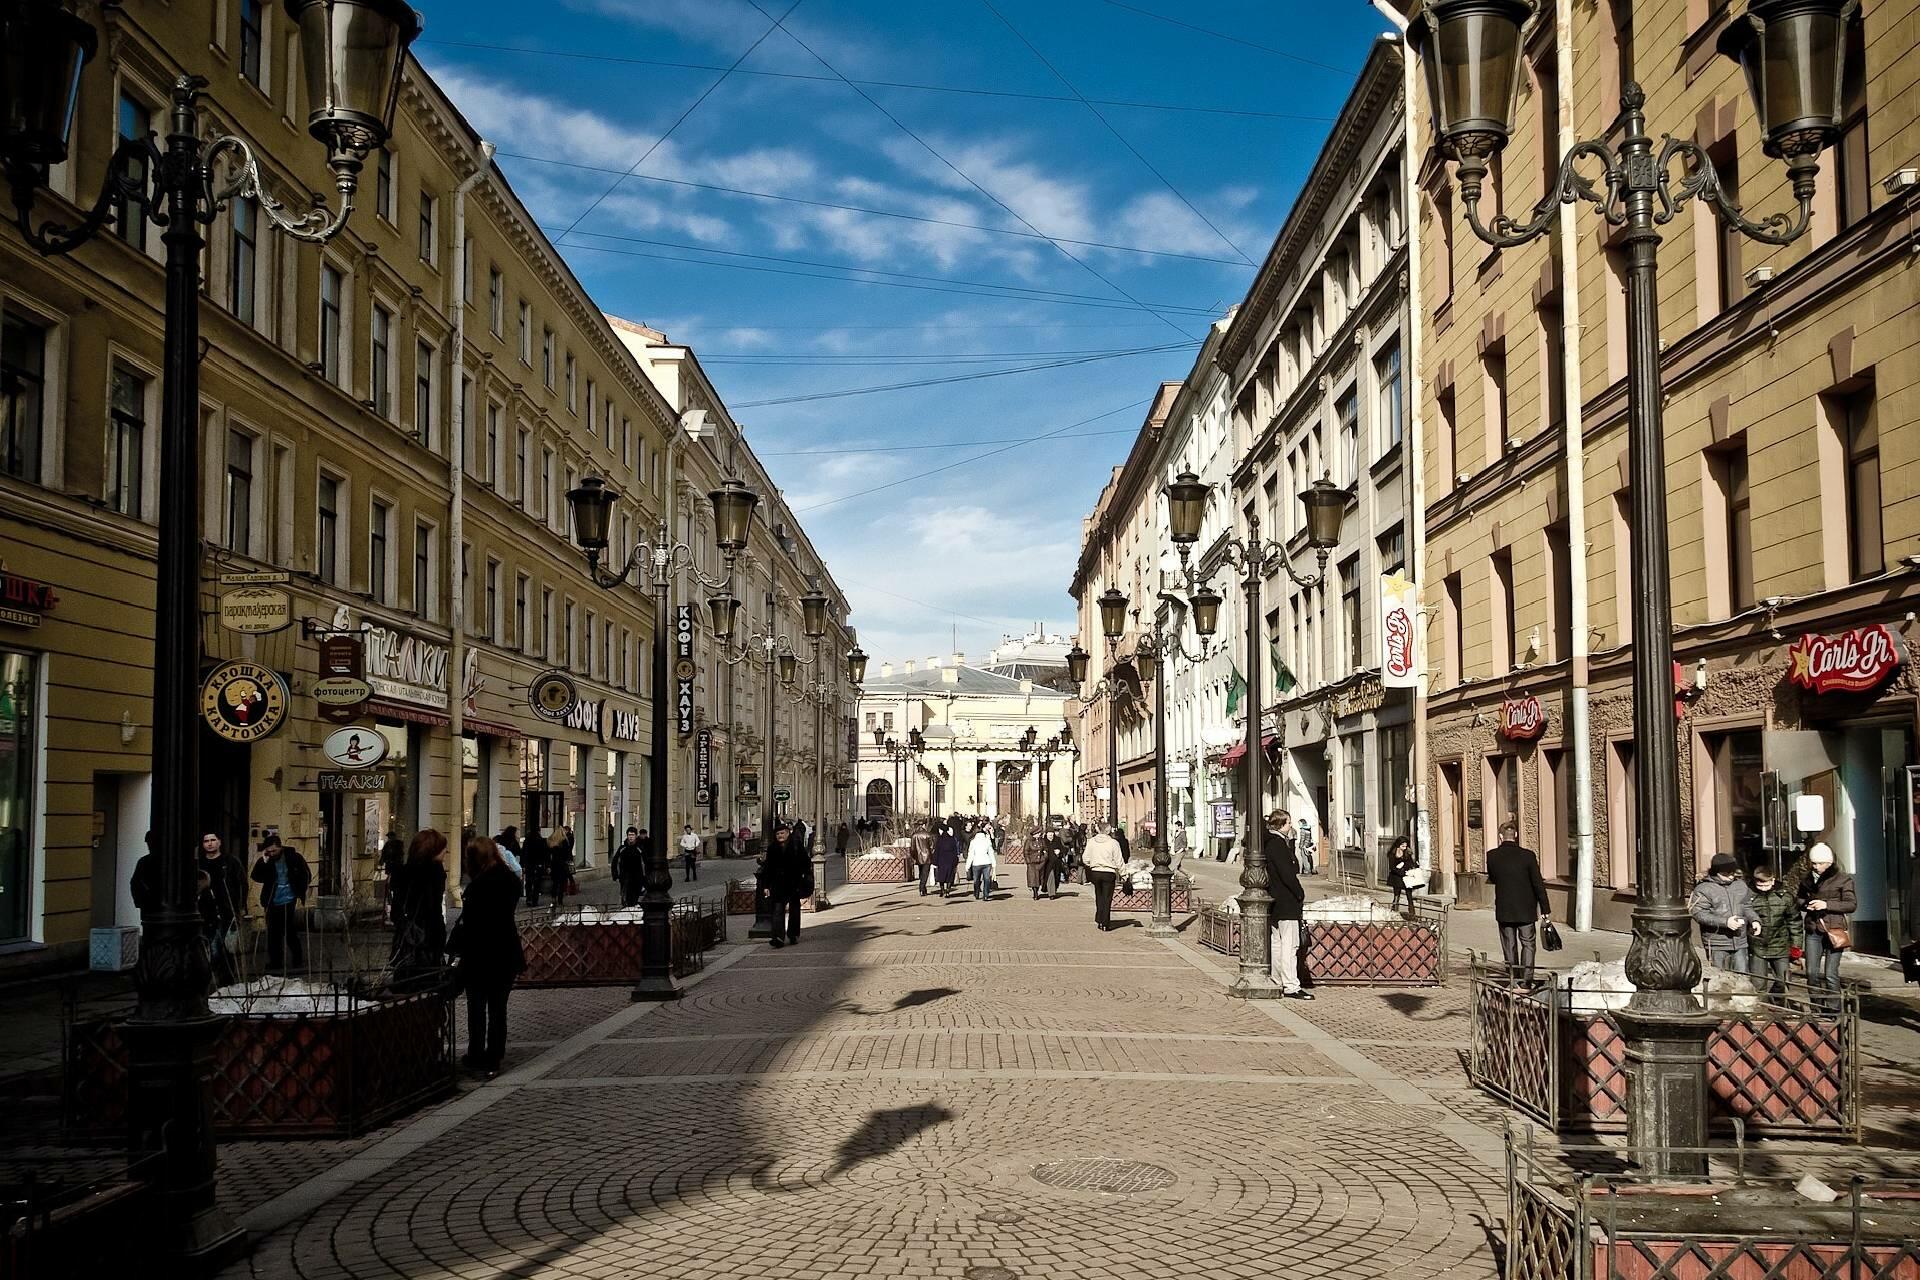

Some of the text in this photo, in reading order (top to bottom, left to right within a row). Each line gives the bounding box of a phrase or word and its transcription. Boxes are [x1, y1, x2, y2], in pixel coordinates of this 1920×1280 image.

[363, 623, 449, 691] ПАЛКИ
[678, 606, 691, 731] КОФЕ ХАУЗ
[1809, 630, 1893, 678] Carl's Jr.
[210, 665, 274, 691] КРОШКА
[313, 687, 366, 698] фотоцентр
[206, 705, 280, 738] КАРТОШКА
[616, 709, 640, 741] ХАУЗ
[320, 774, 386, 789] ПАЛКИ
